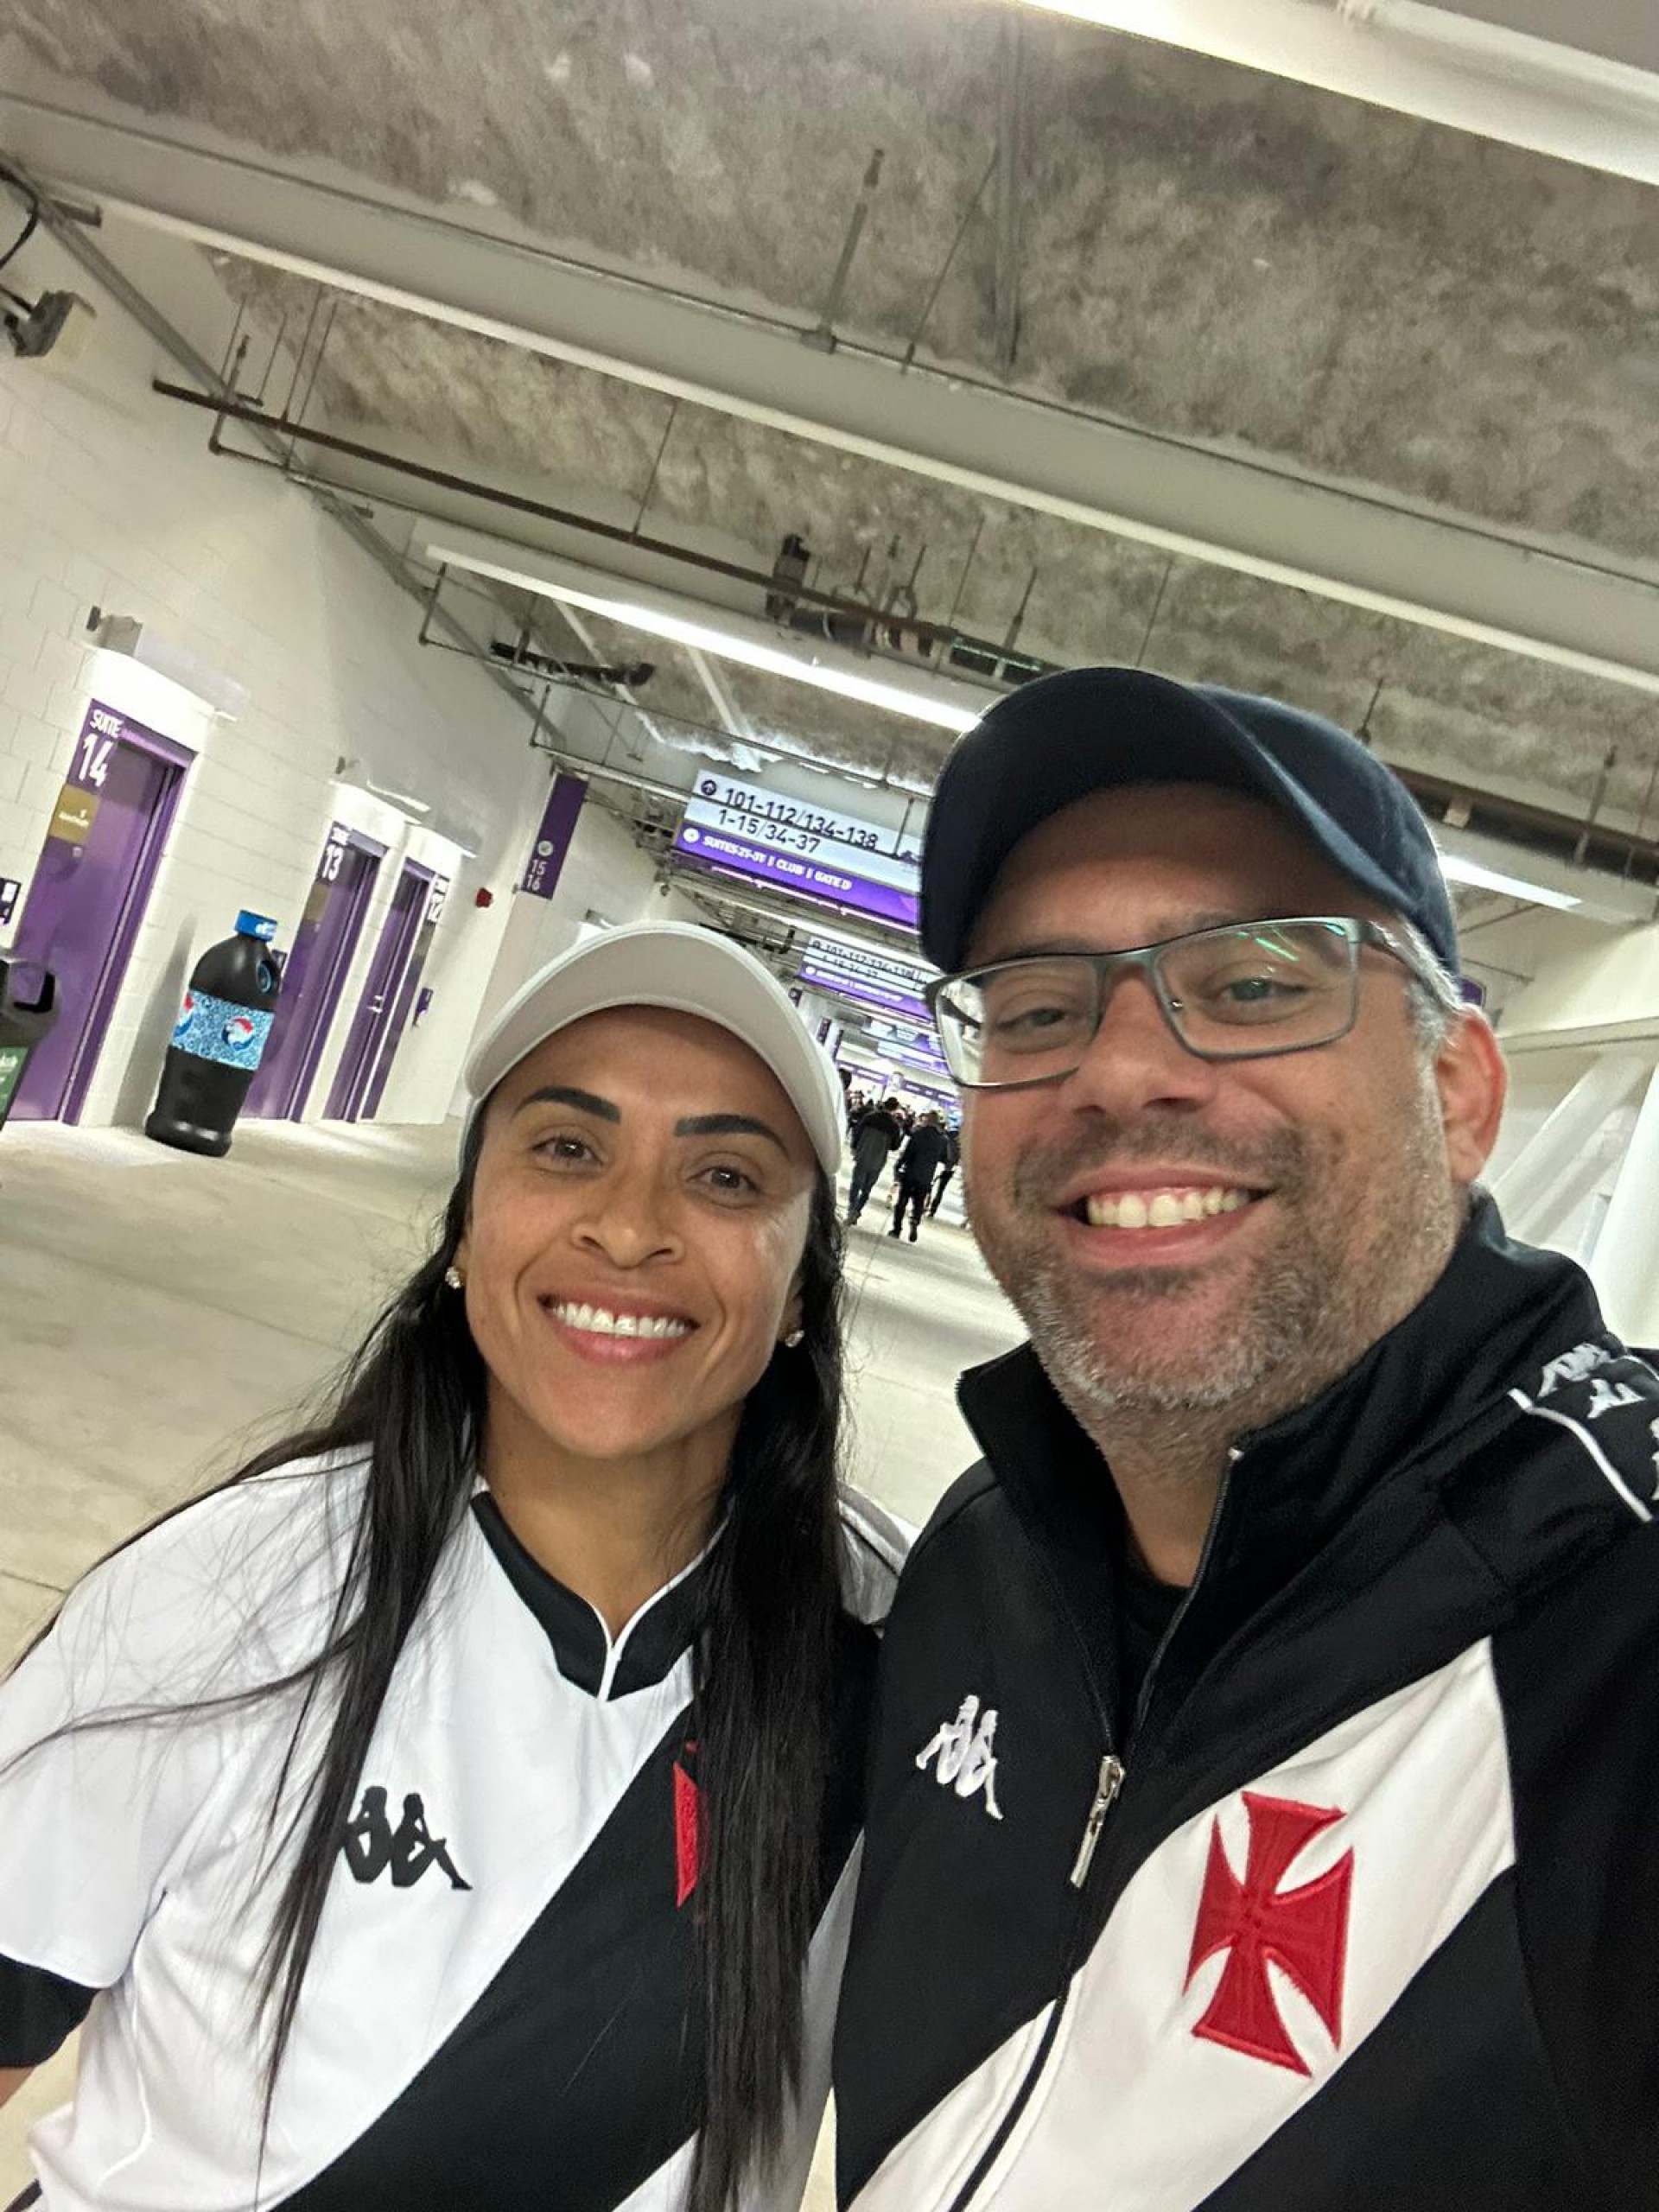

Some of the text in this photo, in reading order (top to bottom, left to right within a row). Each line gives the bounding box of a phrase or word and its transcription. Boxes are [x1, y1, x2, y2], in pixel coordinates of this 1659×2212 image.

[90, 709, 123, 738] SUITE
[79, 733, 113, 787] 14
[719, 809, 820, 853] 1-15/34-37
[322, 844, 344, 881] 13
[532, 860, 548, 875] 15
[527, 874, 542, 891] 16
